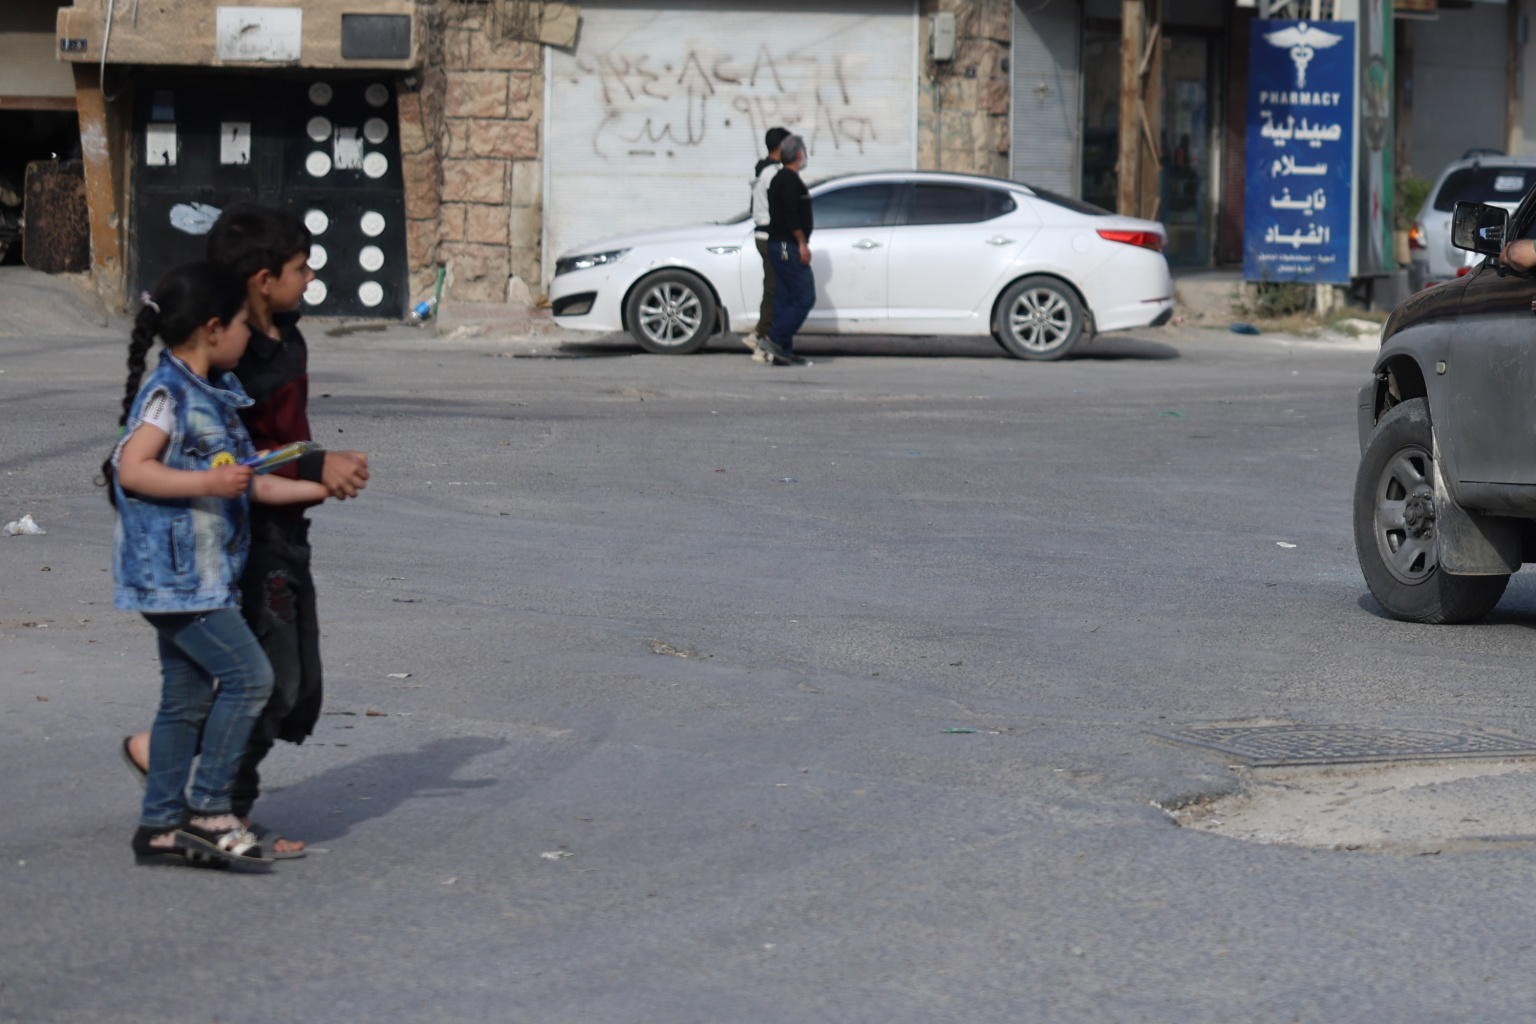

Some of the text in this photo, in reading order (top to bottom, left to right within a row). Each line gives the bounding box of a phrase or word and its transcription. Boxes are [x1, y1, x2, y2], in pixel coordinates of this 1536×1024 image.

[1260, 92, 1341, 106] PHARMACY
[1260, 112, 1342, 149] صيدلية
[1271, 156, 1328, 178] سلام
[1270, 189, 1326, 215] نايف
[1264, 224, 1330, 250] الفهاد
